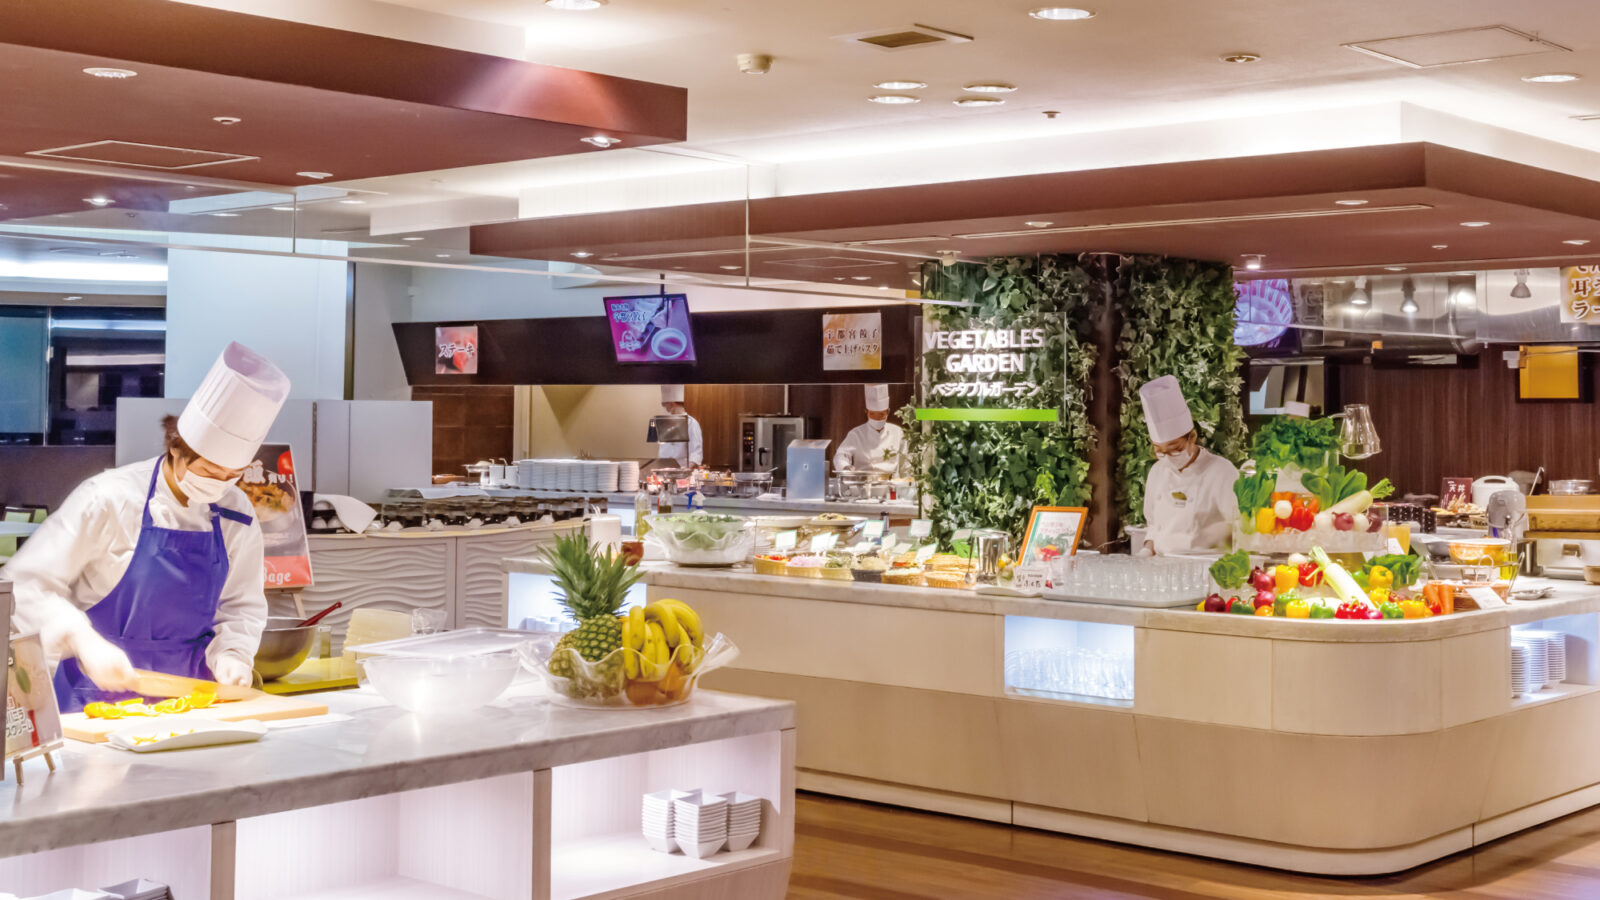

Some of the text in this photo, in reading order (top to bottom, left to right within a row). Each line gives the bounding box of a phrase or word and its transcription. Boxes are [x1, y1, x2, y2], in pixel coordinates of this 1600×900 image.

[924, 329, 1044, 349] VEGETABLES
[438, 342, 475, 358] ステーキ
[946, 352, 1026, 372] GARDEN
